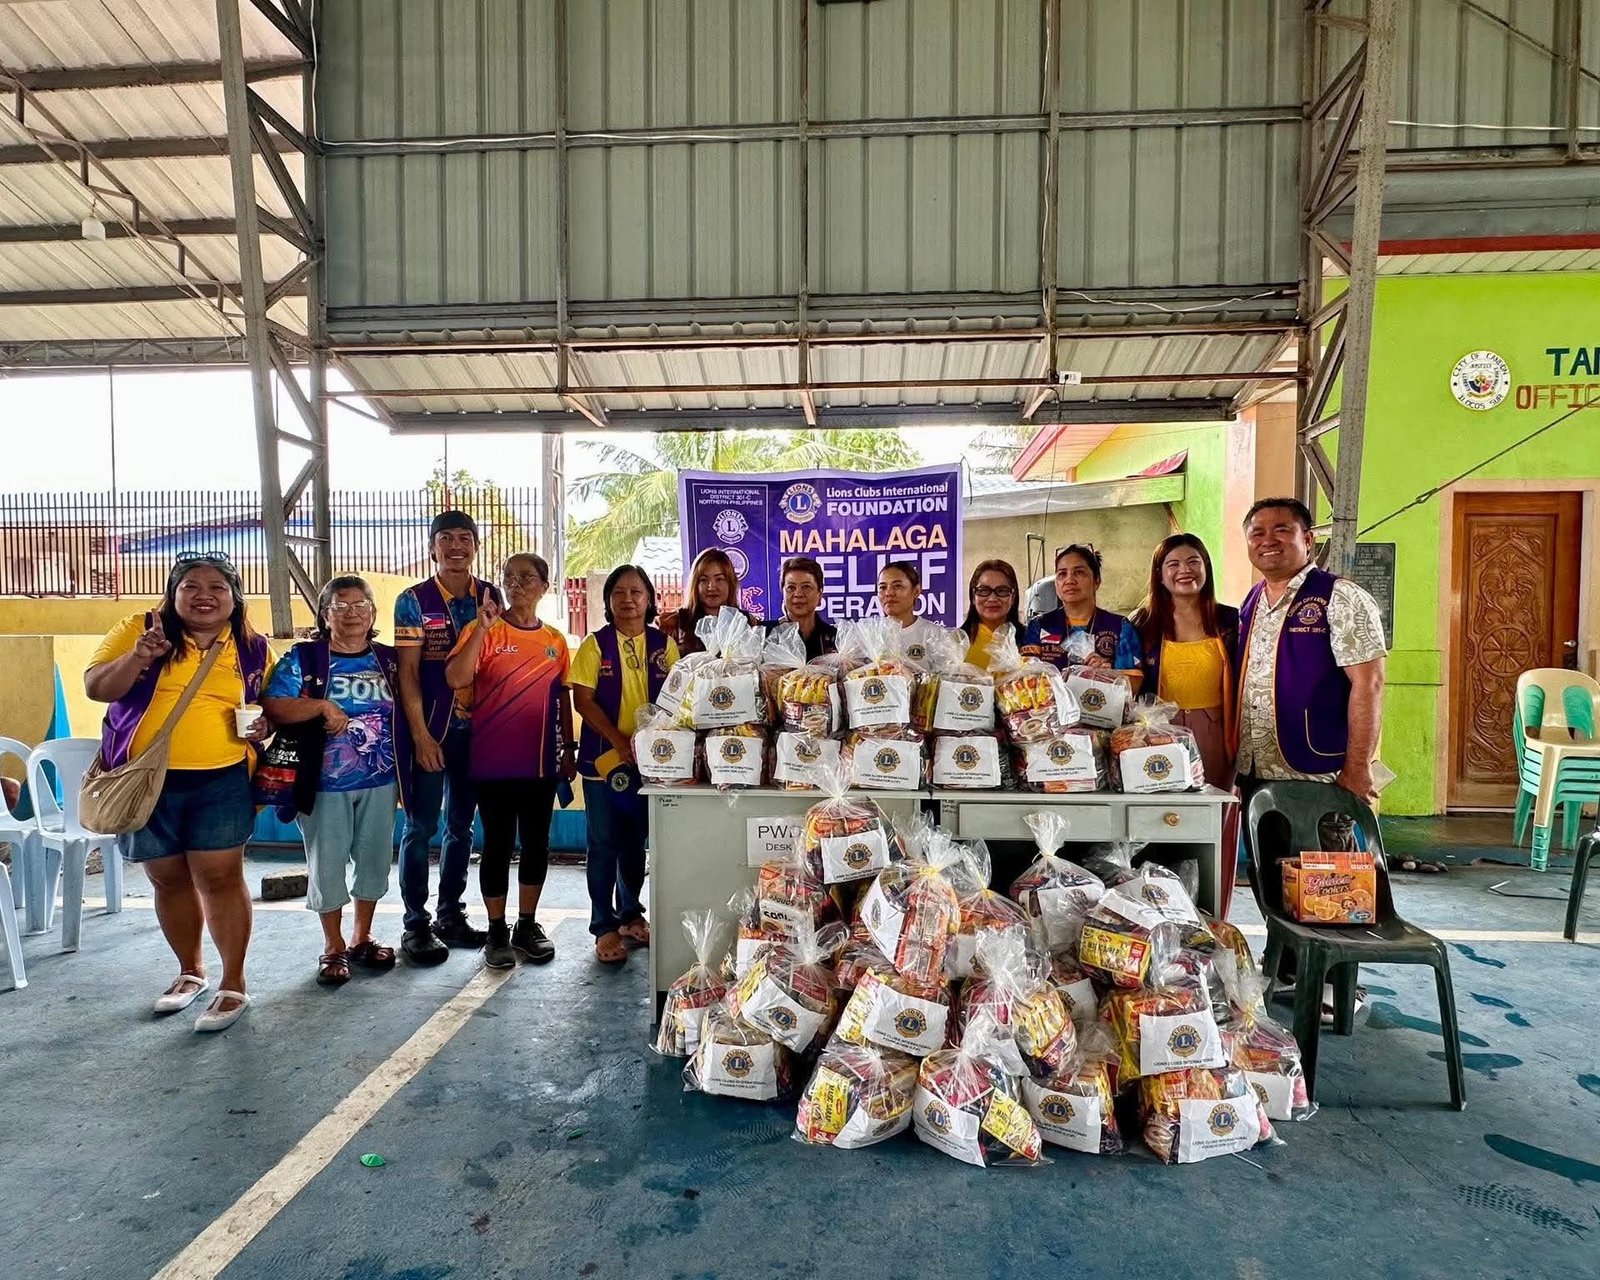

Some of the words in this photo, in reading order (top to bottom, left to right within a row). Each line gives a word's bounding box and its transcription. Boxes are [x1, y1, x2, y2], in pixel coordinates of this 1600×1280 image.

[1453, 359, 1468, 377] CITY
[1545, 347, 1600, 376] TA
[1458, 394, 1486, 409] ILOCOS
[789, 484, 813, 494] LIONS
[826, 487, 853, 498] Lions
[854, 485, 882, 497] Clubs
[883, 481, 949, 496] International
[795, 495, 807, 510] L
[826, 497, 948, 517] FOUNDATION
[719, 509, 742, 519] LIONS
[727, 520, 736, 532] L
[779, 524, 948, 554] MAHALAGA
[780, 551, 949, 595] ELIF
